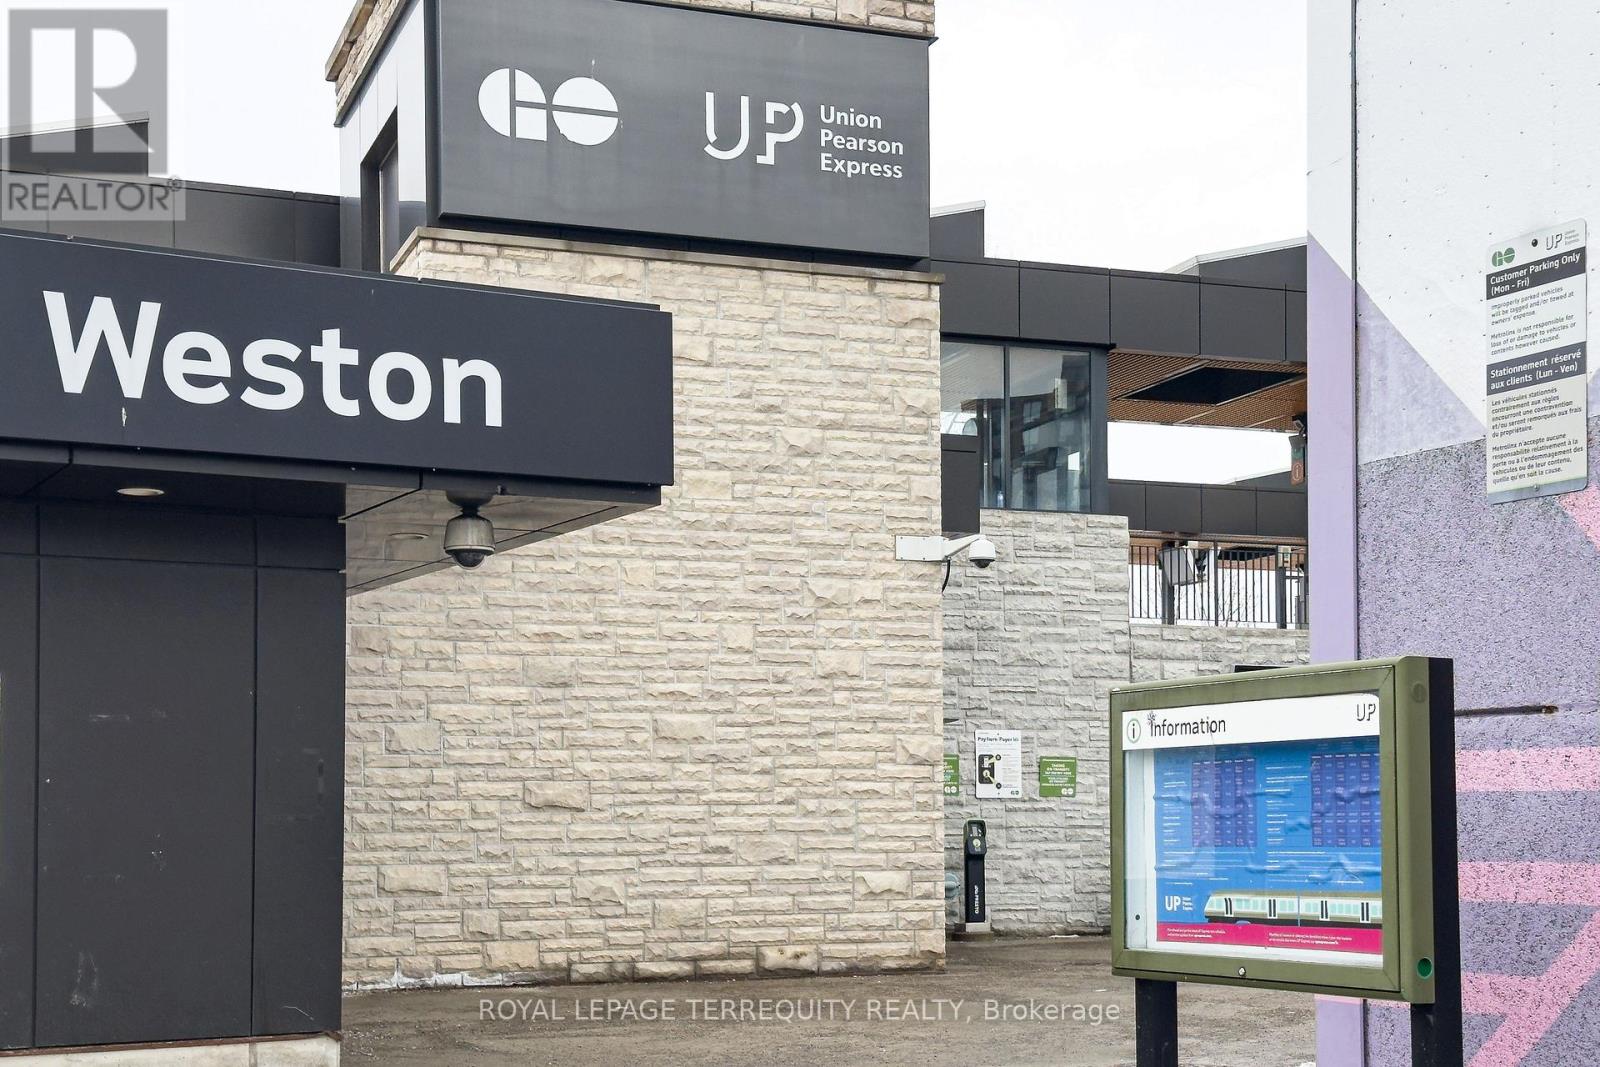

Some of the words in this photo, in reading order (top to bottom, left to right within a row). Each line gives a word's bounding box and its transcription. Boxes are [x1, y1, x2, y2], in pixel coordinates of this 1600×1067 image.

[478, 68, 619, 145] GO
[820, 105, 882, 129] Union
[704, 92, 804, 165] UP
[820, 129, 904, 155] Pearson
[820, 153, 904, 179] Express
[1546, 233, 1563, 250] UP
[1490, 269, 1527, 284] Customer
[1530, 260, 1559, 274] Parking
[1561, 253, 1580, 264] Only
[1492, 247, 1515, 267] GO
[1491, 285, 1510, 296] (Mon
[1517, 277, 1529, 288] Fri)
[43, 290, 502, 427] Weston
[1491, 358, 1548, 378] Stationnement
[1551, 349, 1581, 364] réservé
[1491, 381, 1504, 389] aux
[1506, 374, 1532, 386] clients
[1536, 370, 1553, 380] (Lun
[1560, 361, 1577, 373] Ven)
[1149, 715, 1226, 737] Information
[1356, 704, 1376, 722] UP
[1165, 896, 1181, 911] UP
